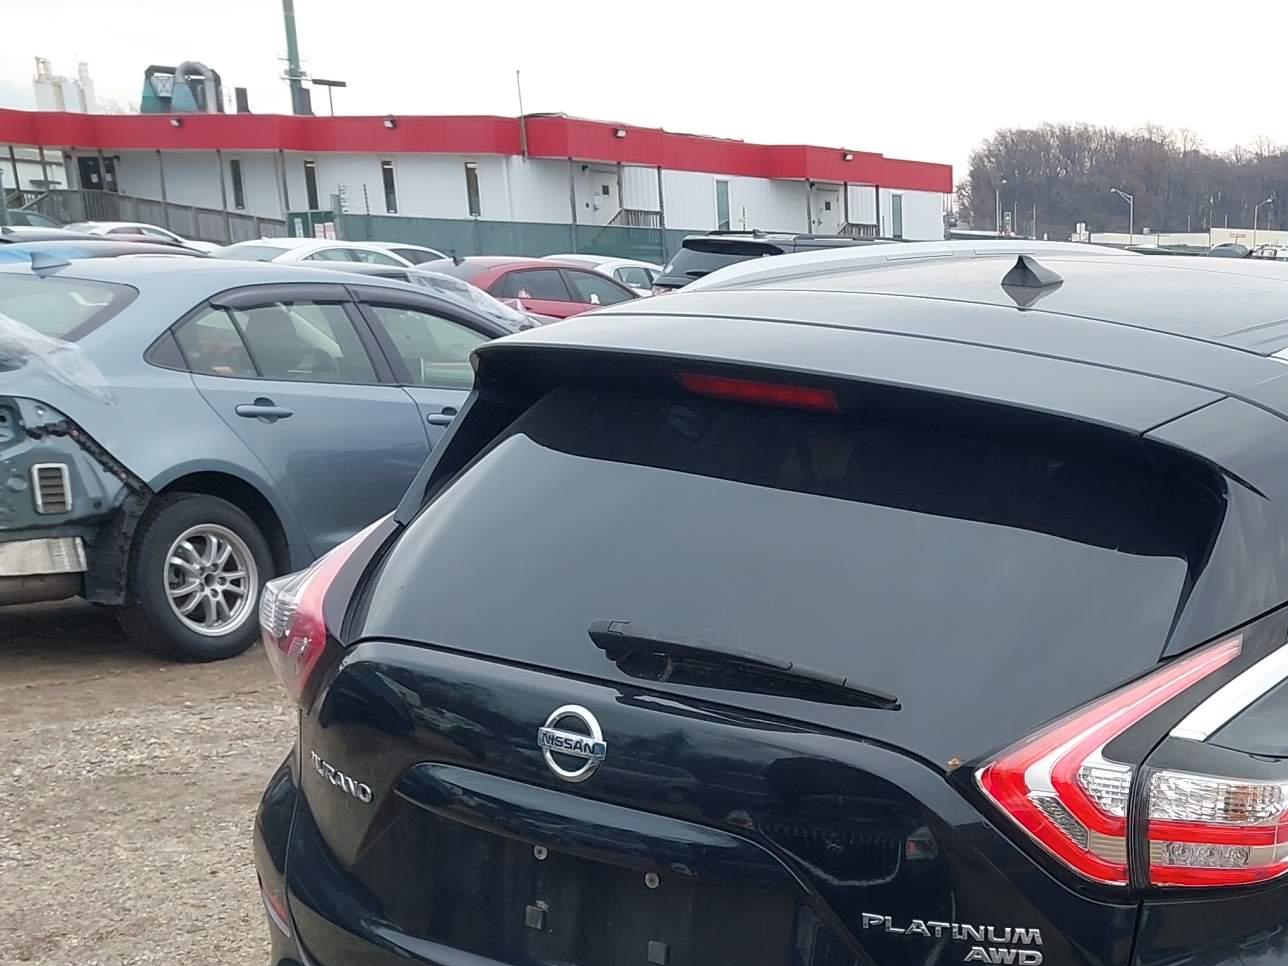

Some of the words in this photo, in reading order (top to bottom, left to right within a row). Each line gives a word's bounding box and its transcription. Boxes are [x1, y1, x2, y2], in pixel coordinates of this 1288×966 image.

[542, 732, 595, 754] NISSAN
[862, 912, 1043, 945] PLATINUM
[963, 946, 1043, 966] AWD
